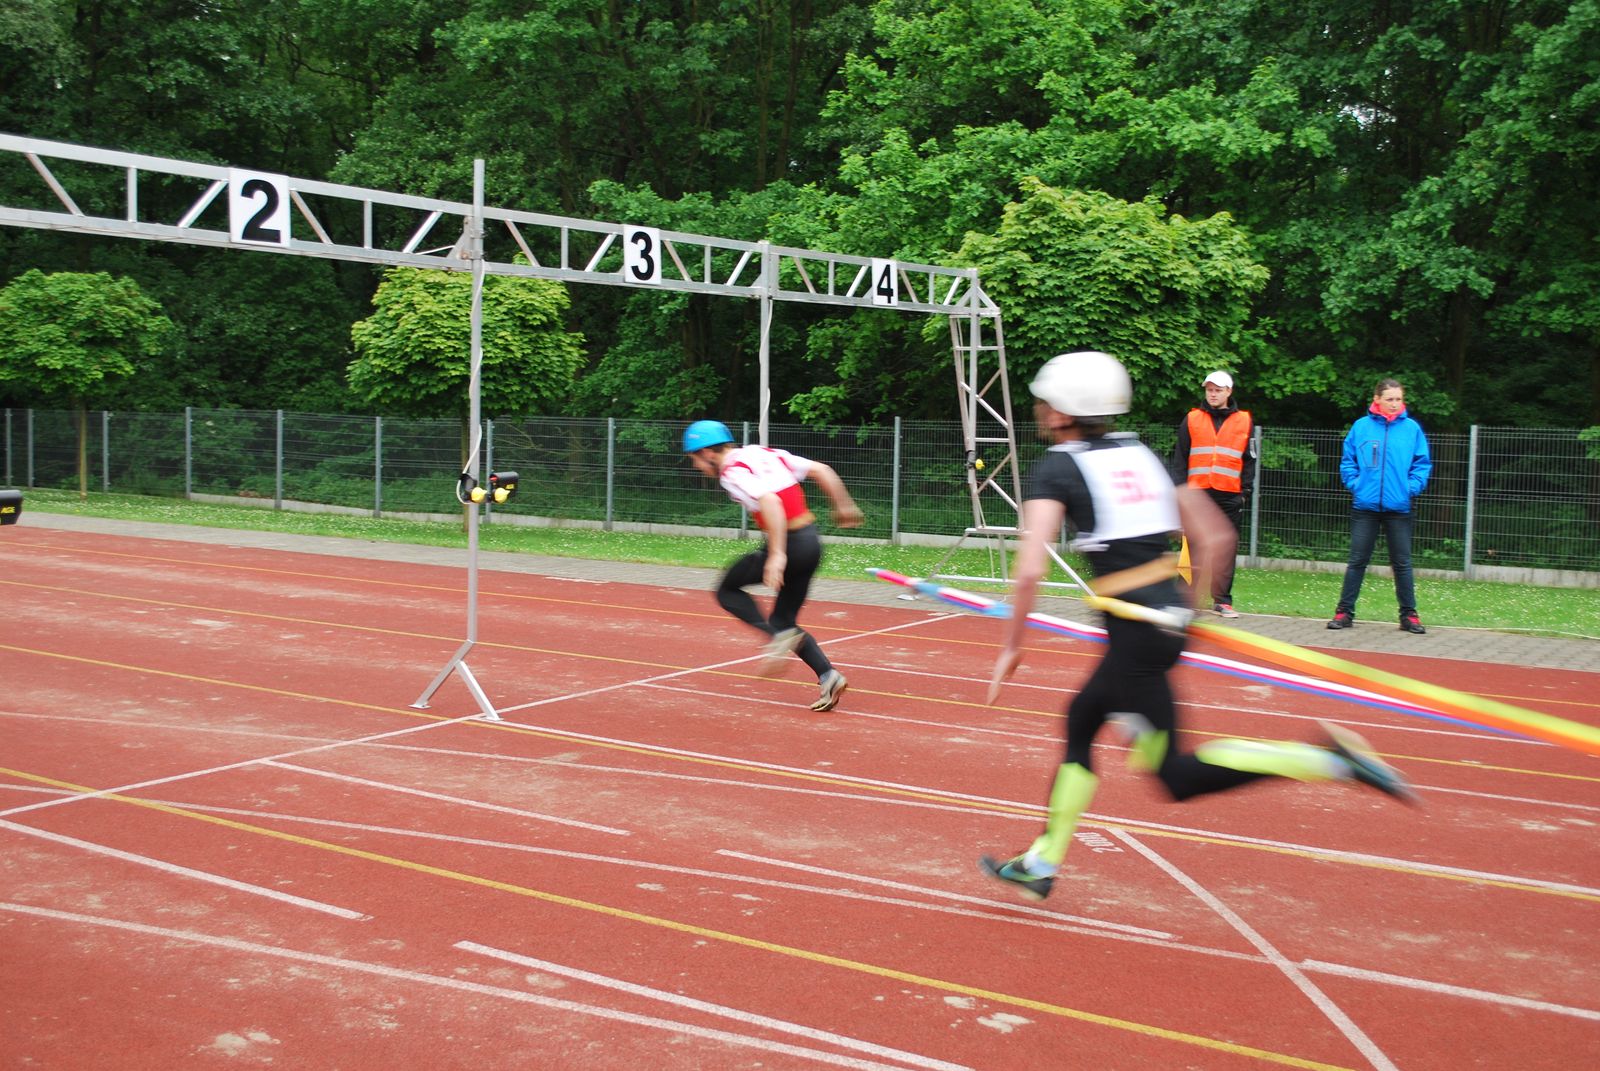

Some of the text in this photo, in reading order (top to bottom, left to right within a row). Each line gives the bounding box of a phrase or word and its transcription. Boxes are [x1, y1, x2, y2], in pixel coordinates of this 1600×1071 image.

[241, 178, 281, 243] 2
[630, 231, 655, 281] 3
[876, 264, 894, 304] 4
